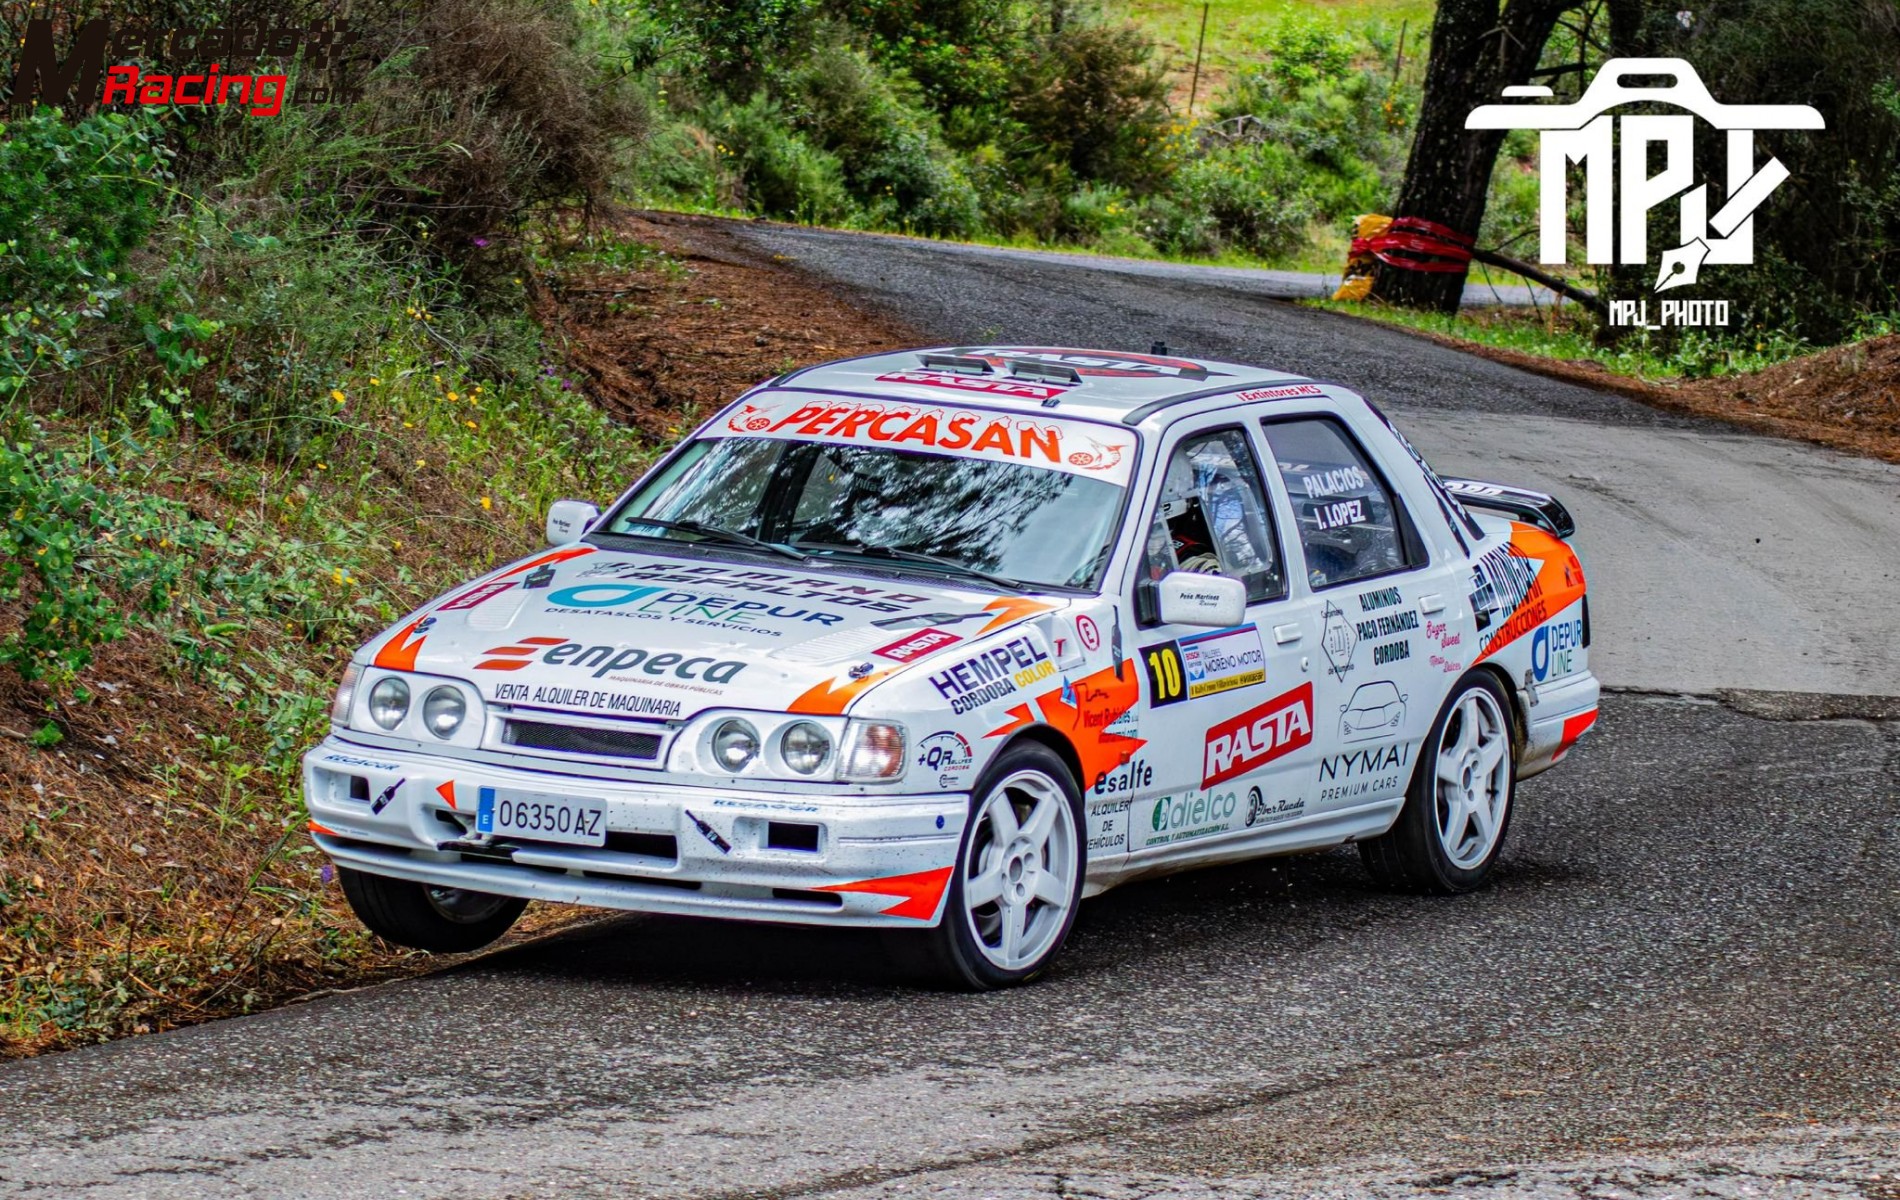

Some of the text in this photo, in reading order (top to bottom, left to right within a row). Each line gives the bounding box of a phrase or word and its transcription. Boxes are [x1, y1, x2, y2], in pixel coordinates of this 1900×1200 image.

[879, 371, 1050, 398] RASTA
[767, 400, 1063, 464] PERCASAN
[1303, 465, 1364, 499] PALACIOS
[1327, 499, 1366, 528] LOPEZ
[616, 572, 911, 612] ASFALTOS
[637, 563, 931, 602] ROMANO
[1359, 586, 1402, 612] ALUMINIOS
[544, 607, 662, 621] DESATASCOS
[684, 618, 783, 637] SERVICIOS
[637, 600, 766, 625] LINE
[659, 592, 845, 627] DEPUR
[1356, 619, 1378, 642] PACO
[1377, 610, 1420, 637] FERNÁNDEZ
[885, 629, 952, 659] RASTA
[1480, 599, 1548, 658] CONSTRUCCIONES
[1552, 619, 1582, 652] DEPUR
[542, 643, 748, 685] enpeca
[928, 636, 1048, 700] HEMPEL
[1205, 650, 1263, 673] MORENO MOTOR
[1374, 639, 1410, 666] CORDOBA
[1551, 650, 1572, 677] LINE
[951, 660, 1056, 715] CORDOBA COLOR
[1149, 648, 1181, 699] 10
[495, 682, 682, 717] VENTA ALQUILER DE MAQUINARIA
[1204, 700, 1312, 782] RASTA
[1094, 758, 1153, 795] esalfe
[1318, 742, 1410, 783] NYMAI
[1321, 775, 1399, 802] PREMIUM CARS
[482, 813, 490, 825] E
[1091, 800, 1129, 817] ALQUILER
[1171, 788, 1236, 829] dielco
[1102, 820, 1114, 832] DE
